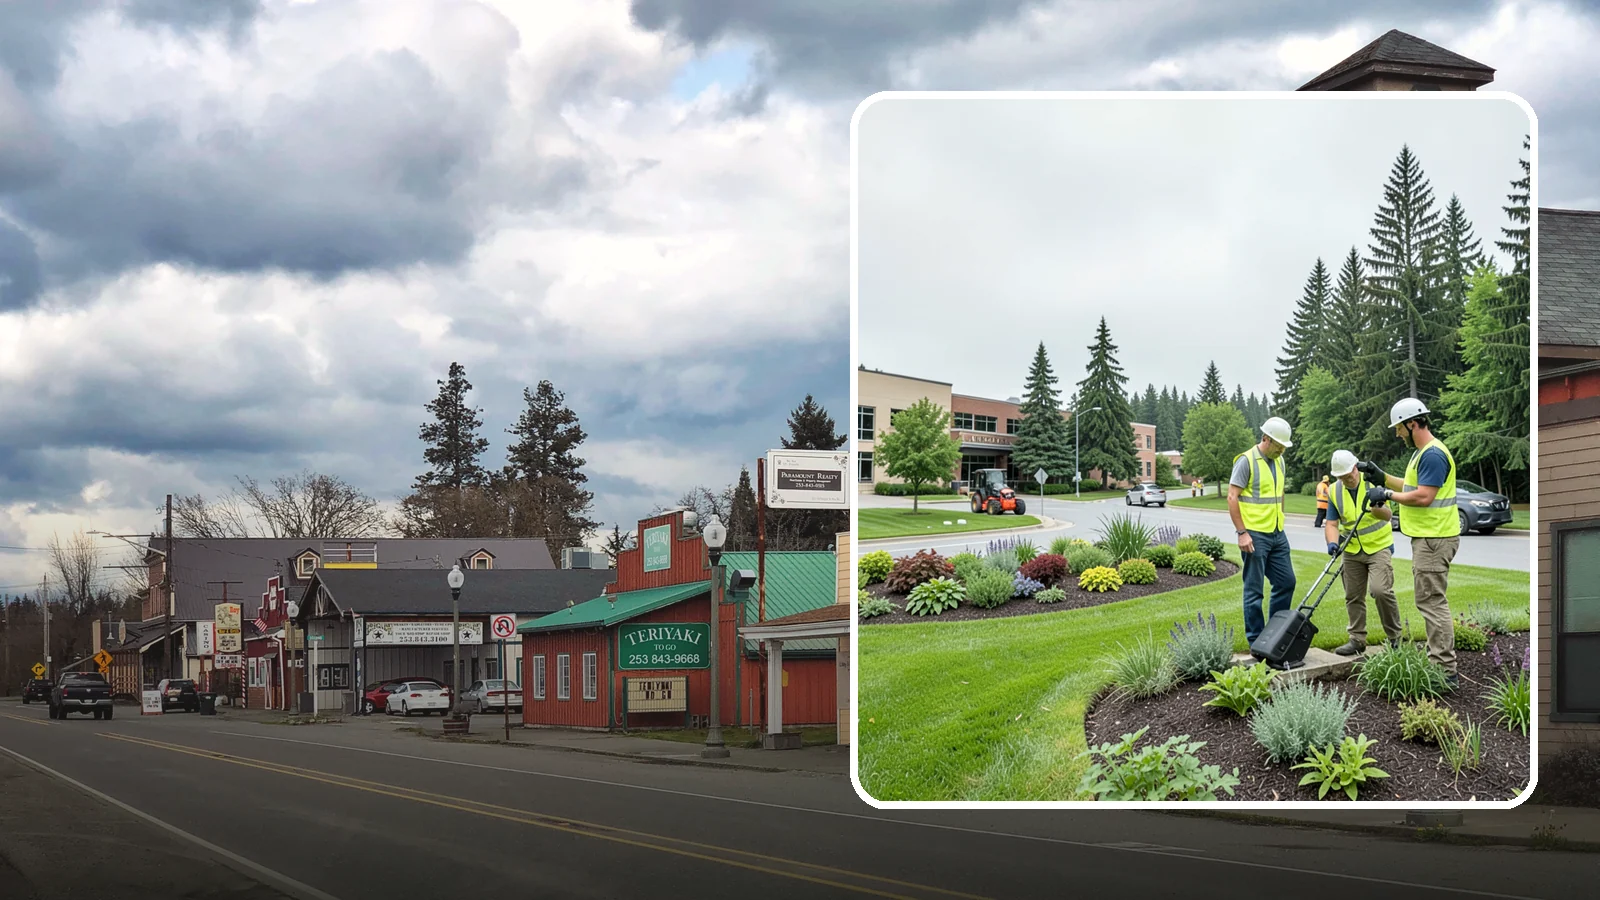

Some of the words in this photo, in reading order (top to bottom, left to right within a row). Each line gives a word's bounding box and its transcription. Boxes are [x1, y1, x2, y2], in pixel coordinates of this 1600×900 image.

[625, 628, 702, 646] TERIYAKI
[628, 655, 649, 665] 253
[651, 654, 700, 664] 843-9668
